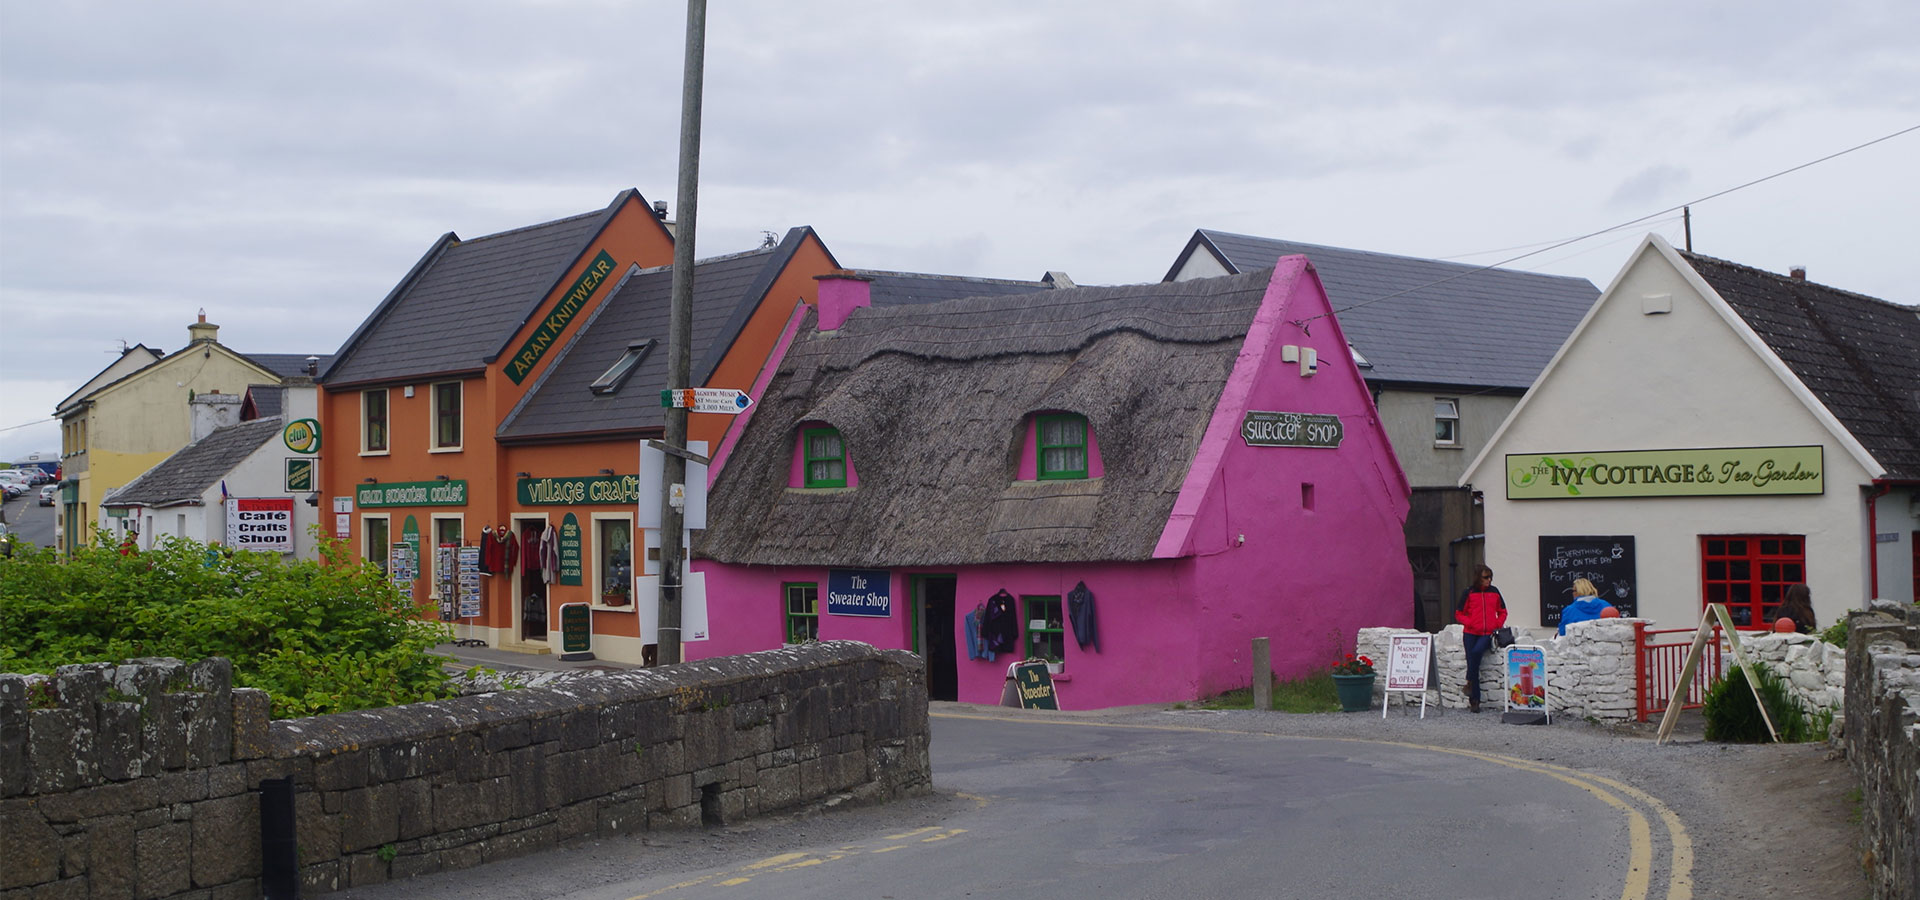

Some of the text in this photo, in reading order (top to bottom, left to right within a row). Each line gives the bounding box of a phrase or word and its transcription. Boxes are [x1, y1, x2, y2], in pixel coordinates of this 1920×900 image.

[513, 260, 610, 376] ARAN KNITWEAR
[720, 390, 736, 398] MUSIC
[289, 427, 307, 443] club
[1531, 459, 1819, 488] THE IVY COTTAGE & Tea Garden
[239, 512, 287, 520] Café
[239, 523, 287, 532] Crafts
[239, 535, 287, 543] Shop
[1549, 556, 1612, 569] MADE ON THE DAY
[851, 575, 867, 590] The
[1567, 571, 1583, 580] THE
[1587, 571, 1604, 583] DAY
[829, 591, 889, 611] Sweater Shop
[1399, 675, 1416, 683] OPEN
[1021, 681, 1051, 700] Sweater
